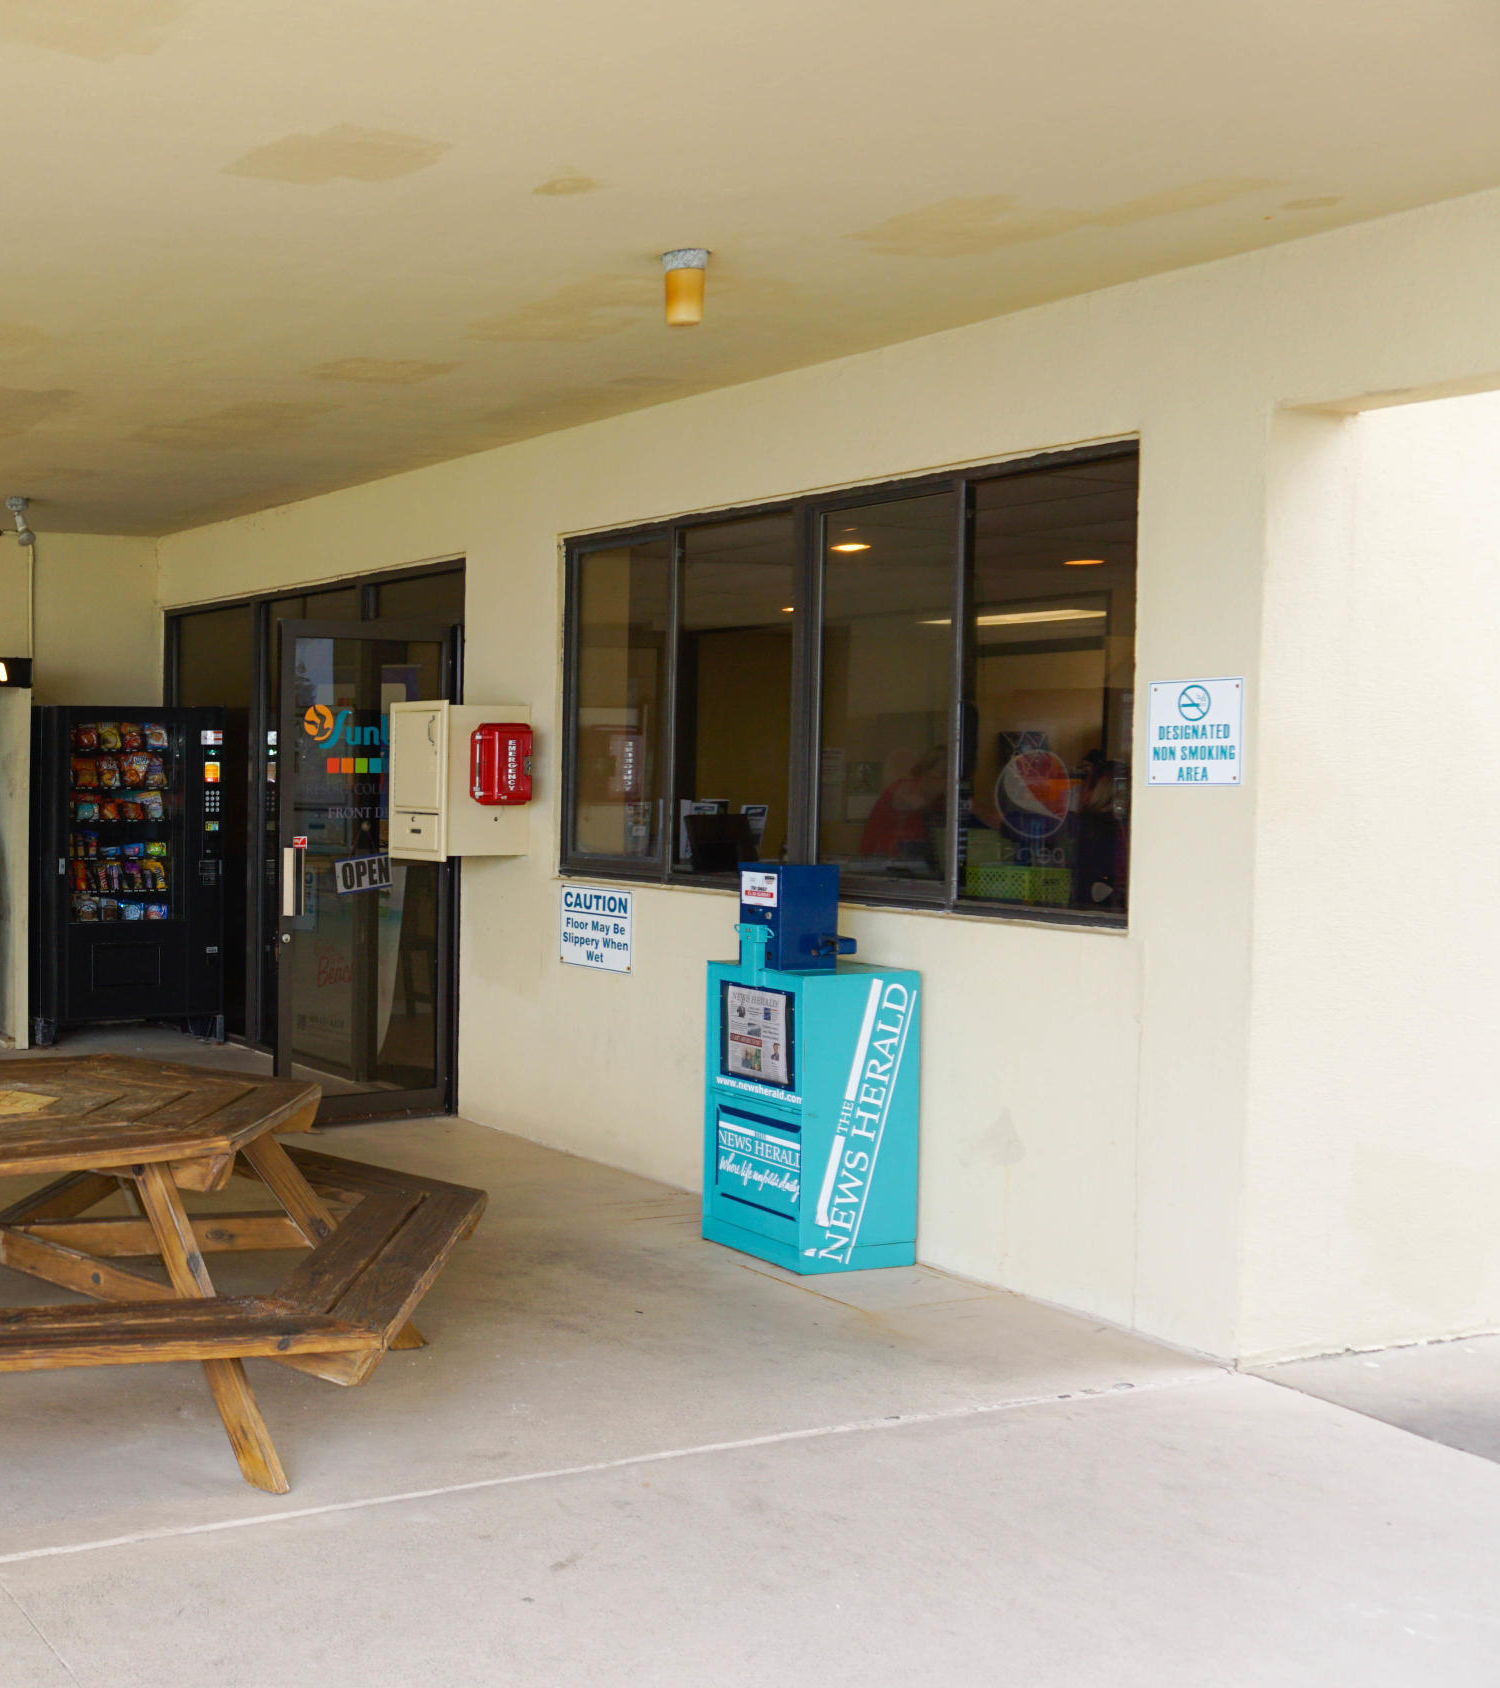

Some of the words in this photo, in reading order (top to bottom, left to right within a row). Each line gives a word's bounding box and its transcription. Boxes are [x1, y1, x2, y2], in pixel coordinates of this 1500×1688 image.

[1158, 723, 1231, 740] DESIGNATED
[1152, 746, 1176, 761] NON
[1180, 745, 1236, 761] SMOKING
[507, 739, 517, 791] EMERGENCY
[1177, 766, 1209, 781] AREA
[328, 807, 371, 819] FRONT
[341, 857, 390, 890] OPEN
[564, 891, 628, 914] CAUTION
[566, 917, 588, 930] Floor
[591, 920, 610, 936] May
[613, 923, 625, 935] Be
[563, 931, 599, 949] Slippery
[602, 937, 628, 951] When
[586, 950, 604, 963] Wet
[818, 1150, 869, 1263] NEWS
[851, 983, 909, 1142] HERALD
[837, 1101, 854, 1134] THE
[718, 1130, 753, 1153] NEWS
